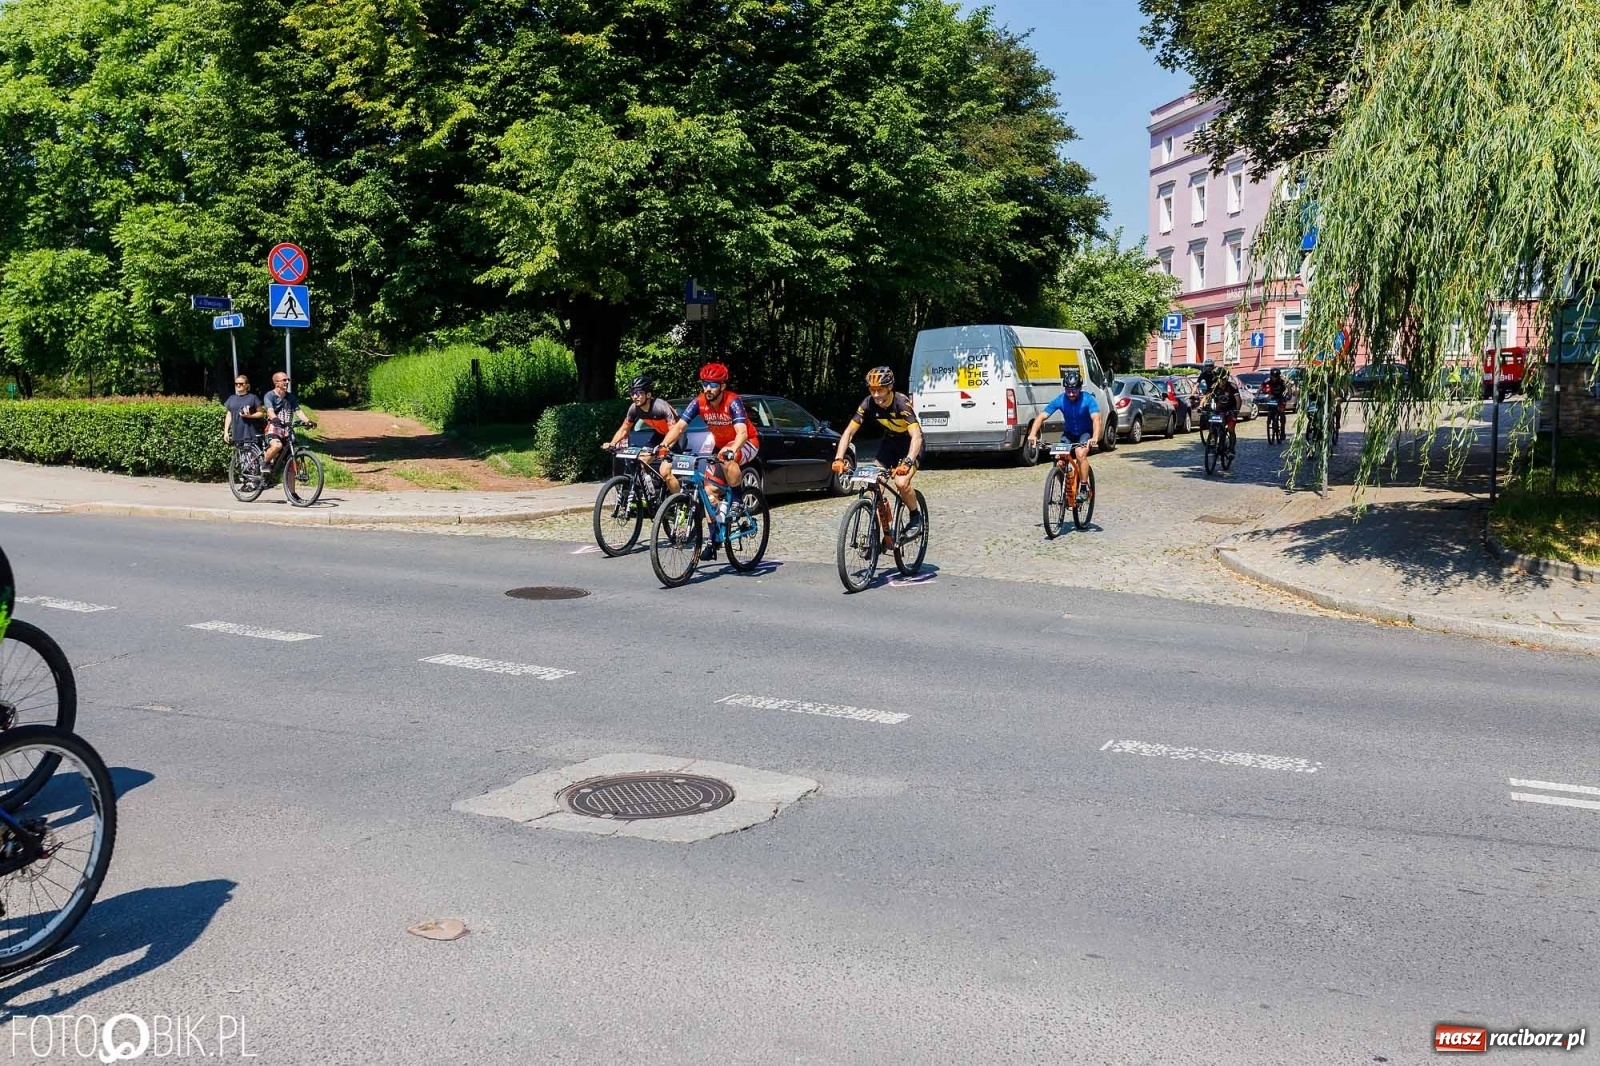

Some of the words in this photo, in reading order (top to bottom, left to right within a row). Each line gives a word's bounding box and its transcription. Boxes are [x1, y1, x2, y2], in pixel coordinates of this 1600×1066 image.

[1167, 316, 1178, 330] P
[967, 354, 989, 362] OUT
[931, 366, 955, 375] InPost
[676, 461, 690, 469] 1219
